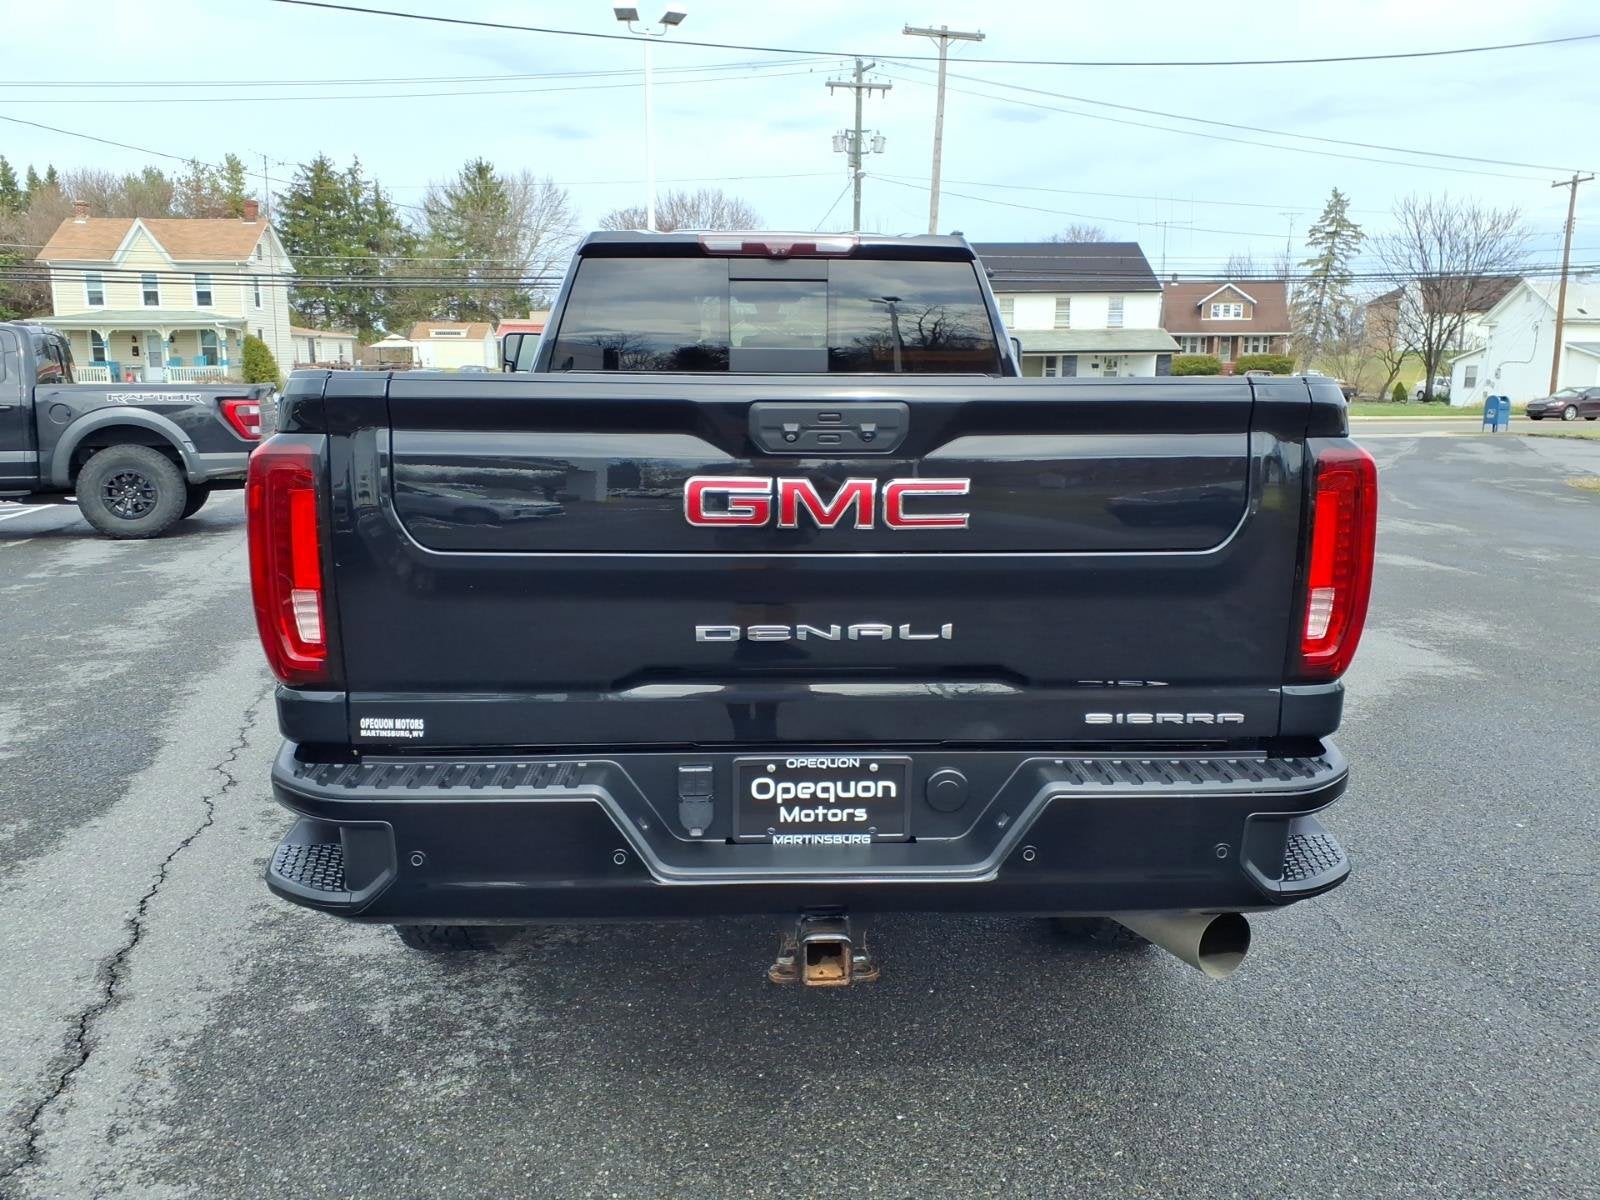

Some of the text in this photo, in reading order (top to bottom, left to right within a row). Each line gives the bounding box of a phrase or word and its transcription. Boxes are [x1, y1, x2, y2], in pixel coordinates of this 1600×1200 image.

[106, 393, 205, 405] RAPTOR
[684, 476, 970, 530] GMC
[695, 623, 953, 642] DENALI
[360, 717, 424, 730] OPEQUON MOTORS
[1085, 713, 1245, 724] SIERRA
[786, 758, 860, 769] OPEQUON
[751, 777, 896, 804] Opequon
[779, 806, 868, 823] Motors
[772, 834, 871, 845] MARTINSBURG
